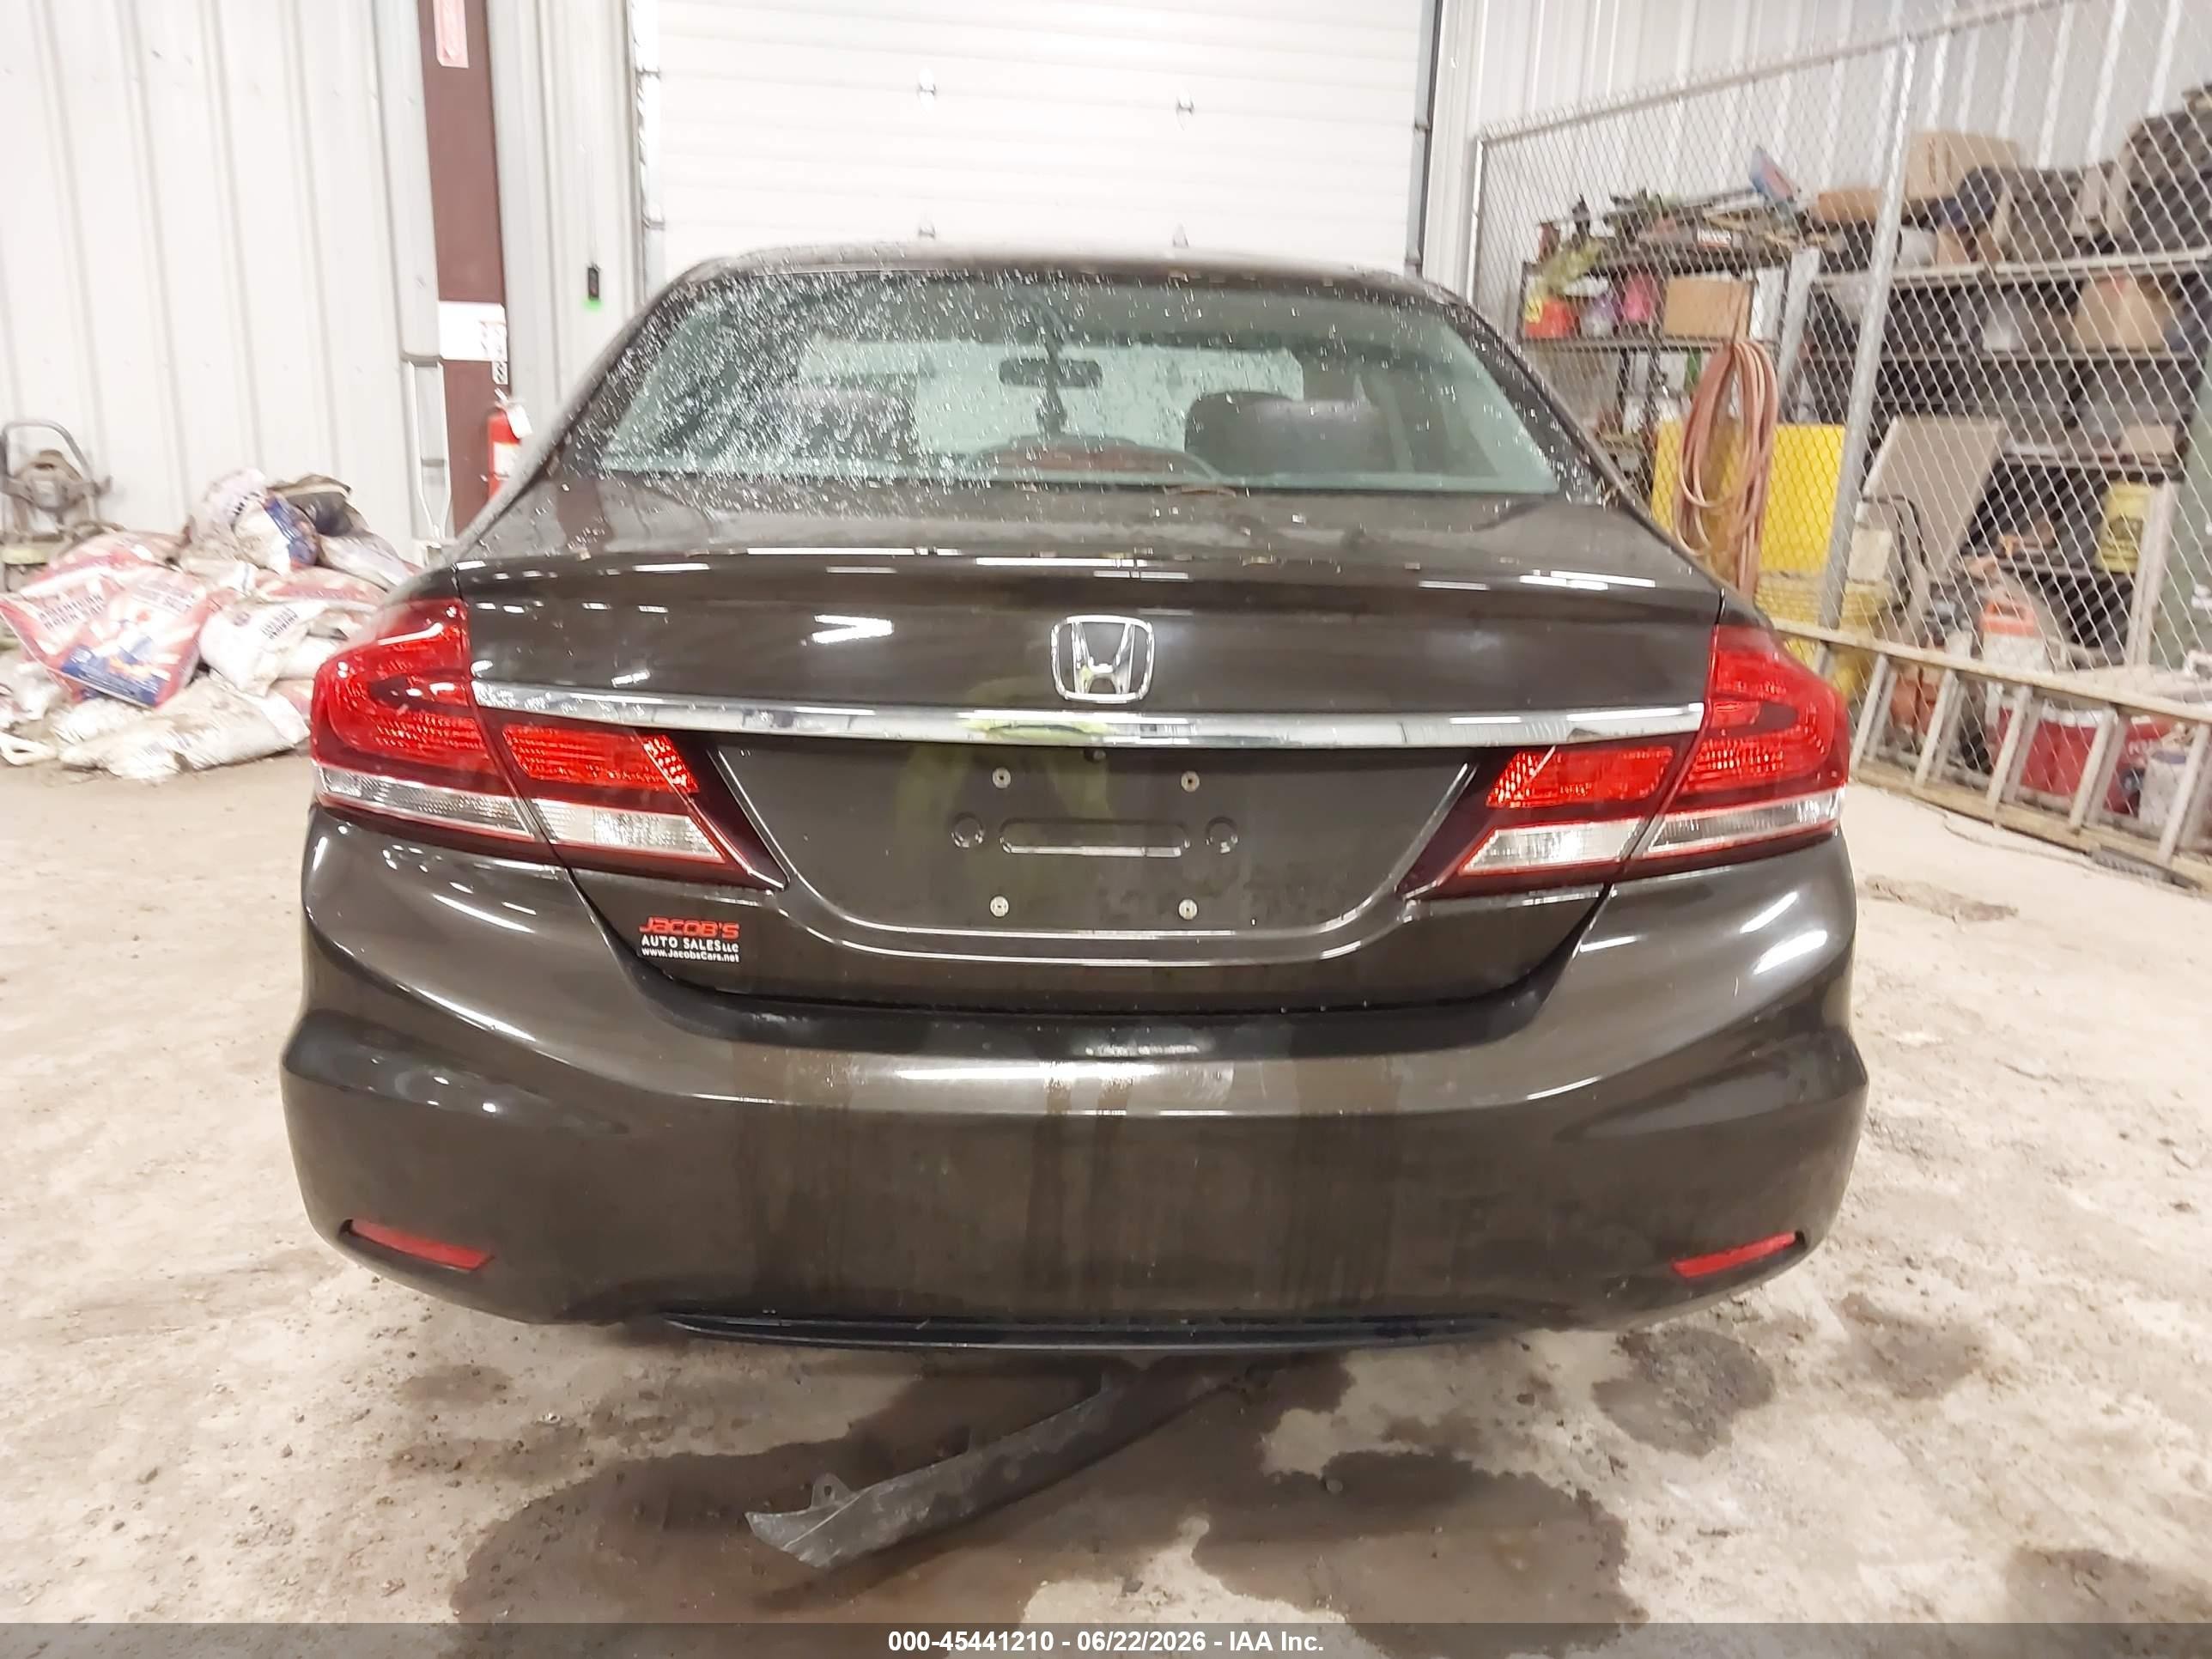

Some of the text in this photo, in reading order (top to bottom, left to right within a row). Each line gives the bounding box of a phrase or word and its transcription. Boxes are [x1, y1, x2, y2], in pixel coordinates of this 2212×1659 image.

[641, 934, 678, 949] AUTO
[683, 938, 721, 952] SALES
[641, 948, 740, 963] www.JacobsCars.net
